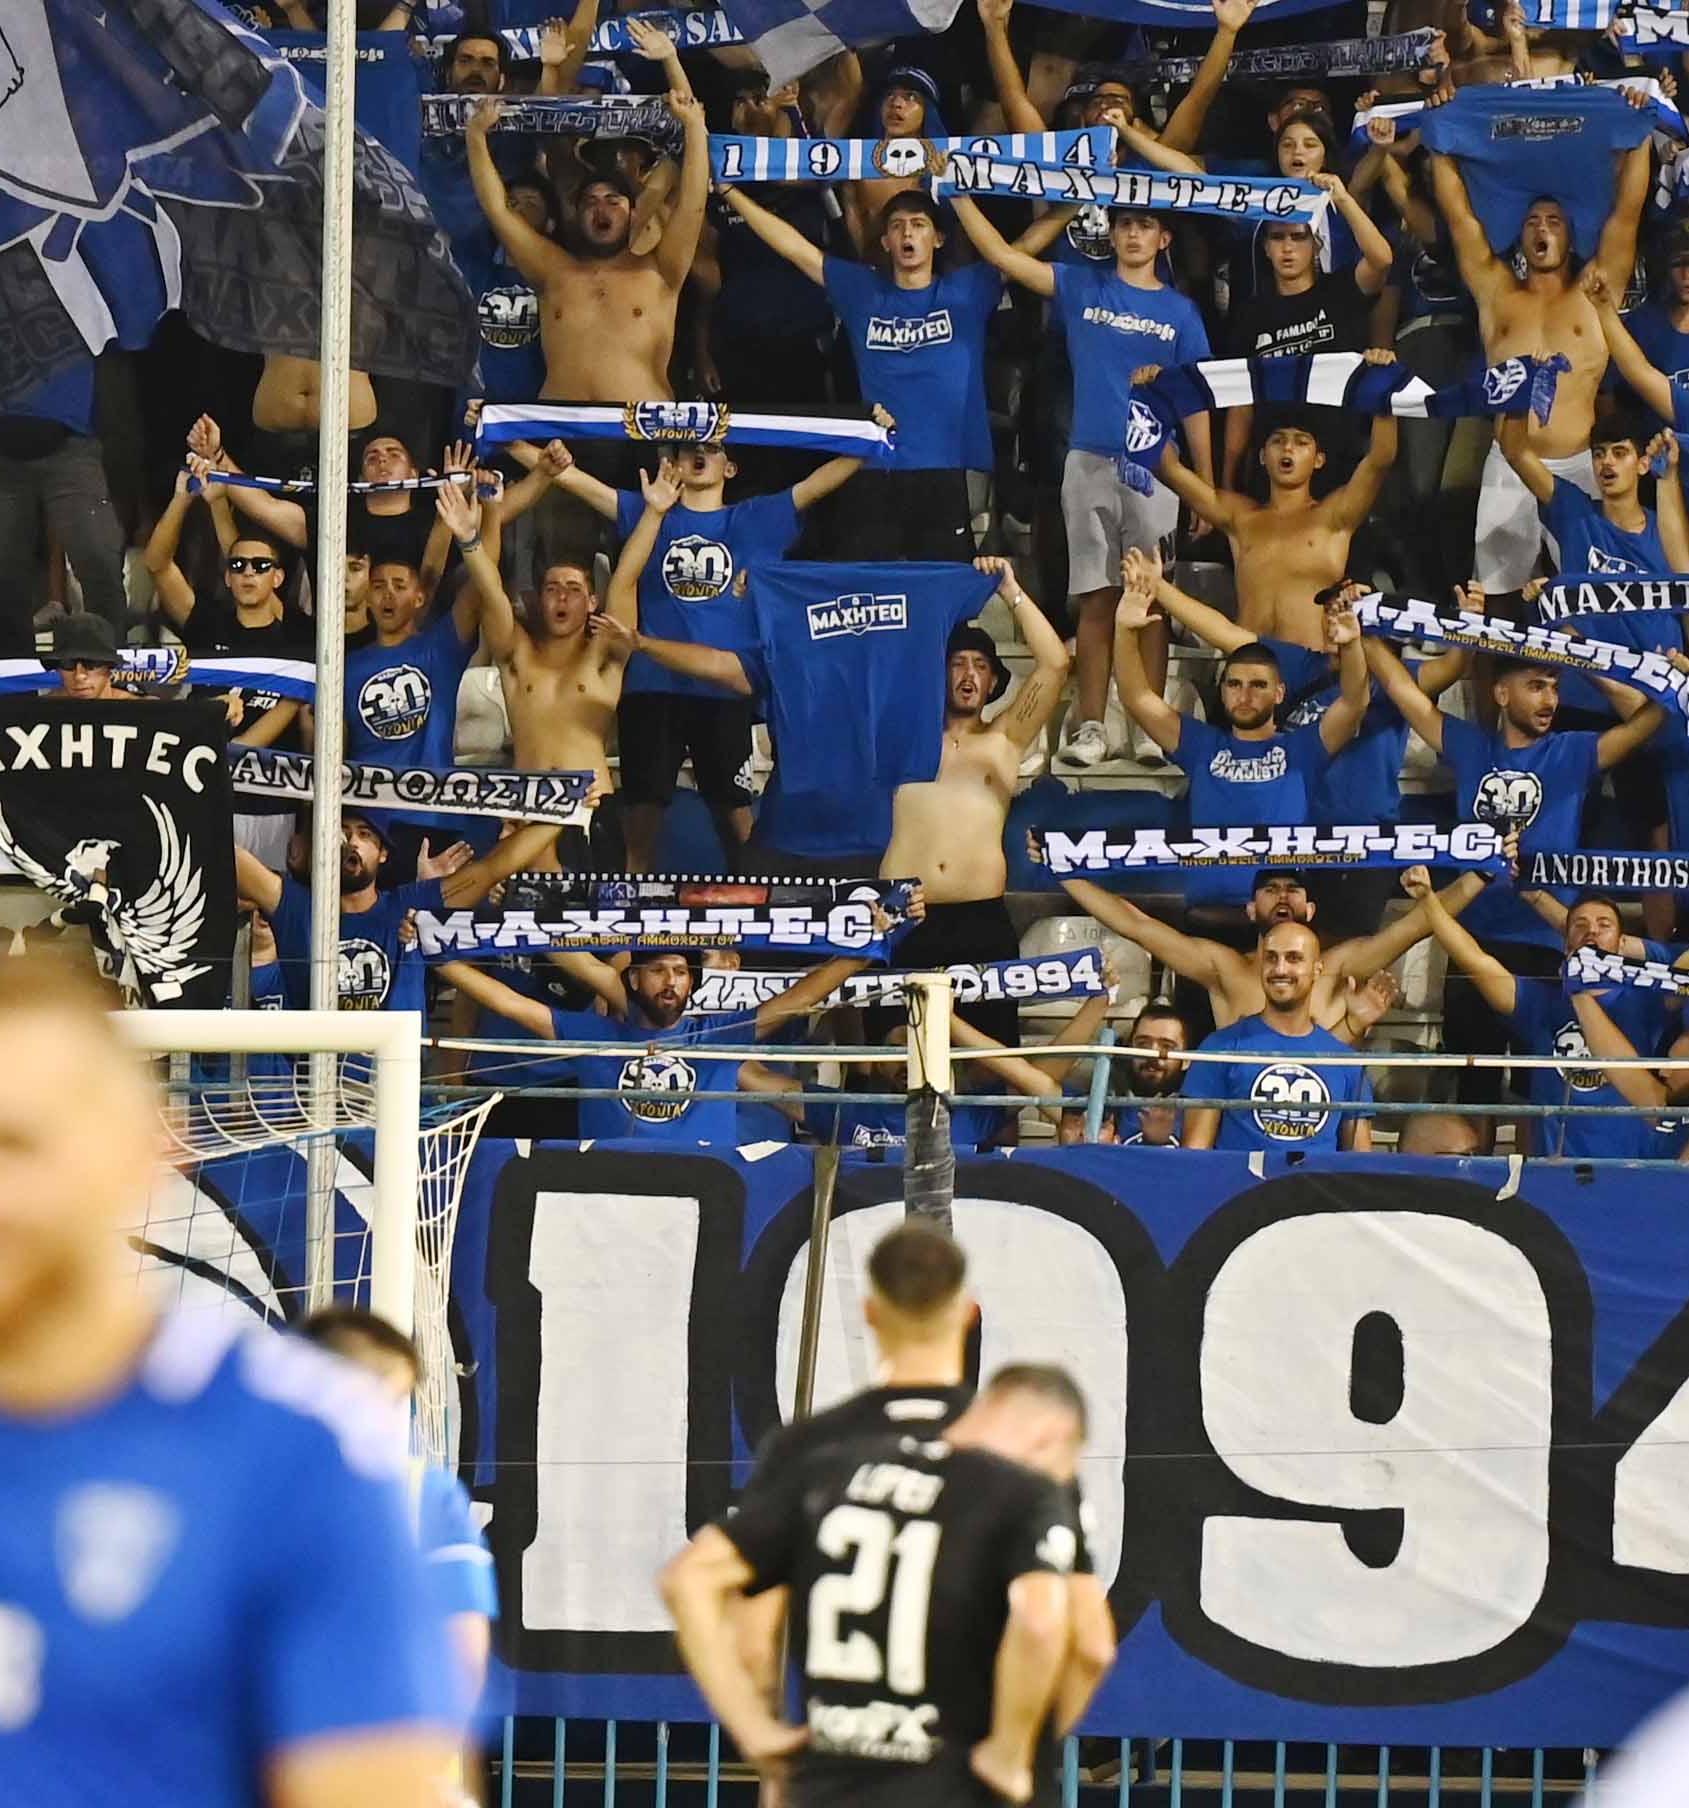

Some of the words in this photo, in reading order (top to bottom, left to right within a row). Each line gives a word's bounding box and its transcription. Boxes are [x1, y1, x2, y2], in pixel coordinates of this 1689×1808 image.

[665, 550, 731, 582] 30
[361, 676, 430, 714] 30
[986, 956, 1100, 996] 1994
[809, 1507, 939, 1684] 21
